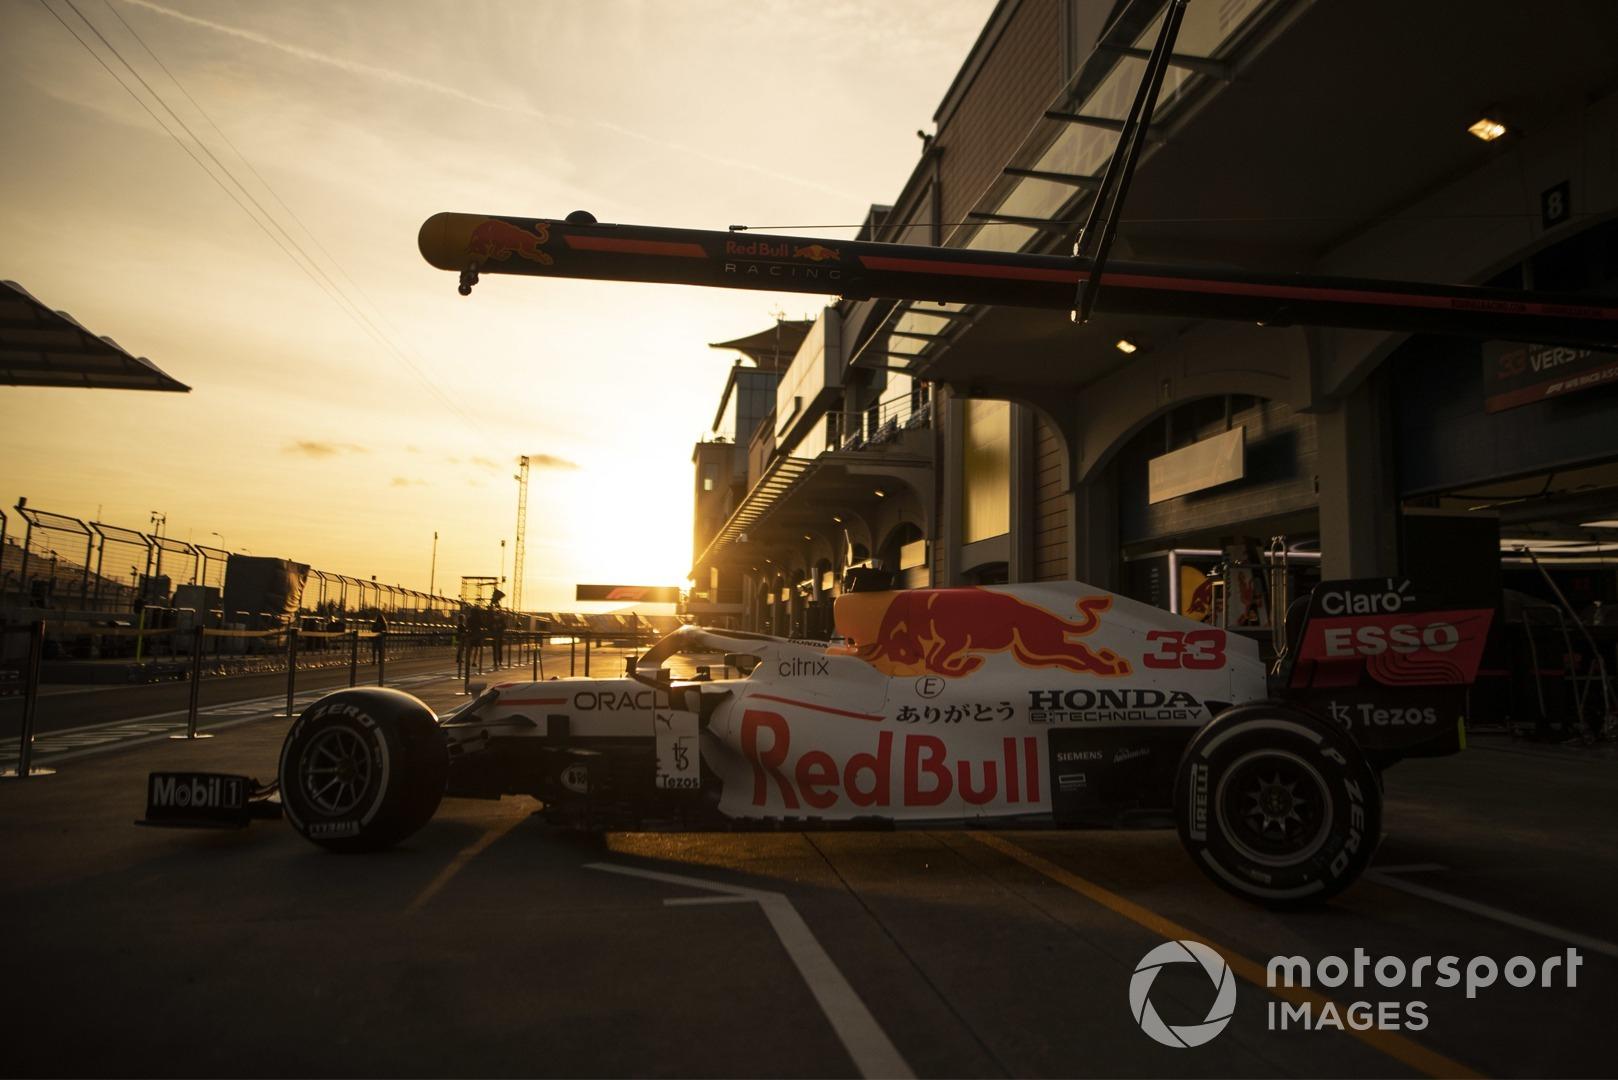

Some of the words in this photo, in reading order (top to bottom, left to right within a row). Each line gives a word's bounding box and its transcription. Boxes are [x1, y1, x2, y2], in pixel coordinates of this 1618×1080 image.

[1547, 190, 1564, 221] 8
[724, 263, 841, 280] RACING
[1530, 346, 1591, 372] VERS
[1321, 591, 1402, 615] Claro
[1143, 629, 1226, 670] 33
[1324, 622, 1460, 657] ESSO
[779, 657, 830, 677] citrix
[574, 690, 670, 711] ORACL
[1028, 689, 1202, 711] HONDA
[310, 703, 376, 729] ZERO
[896, 701, 1014, 724] ありがとう
[1356, 703, 1438, 726] Tezos
[1057, 750, 1104, 762] SIEMENS
[1320, 747, 1347, 766] P
[153, 777, 221, 808] Mobil
[662, 774, 699, 788] Tezos
[1189, 763, 1209, 841] PIRELLI
[1329, 777, 1365, 879] ZERO
